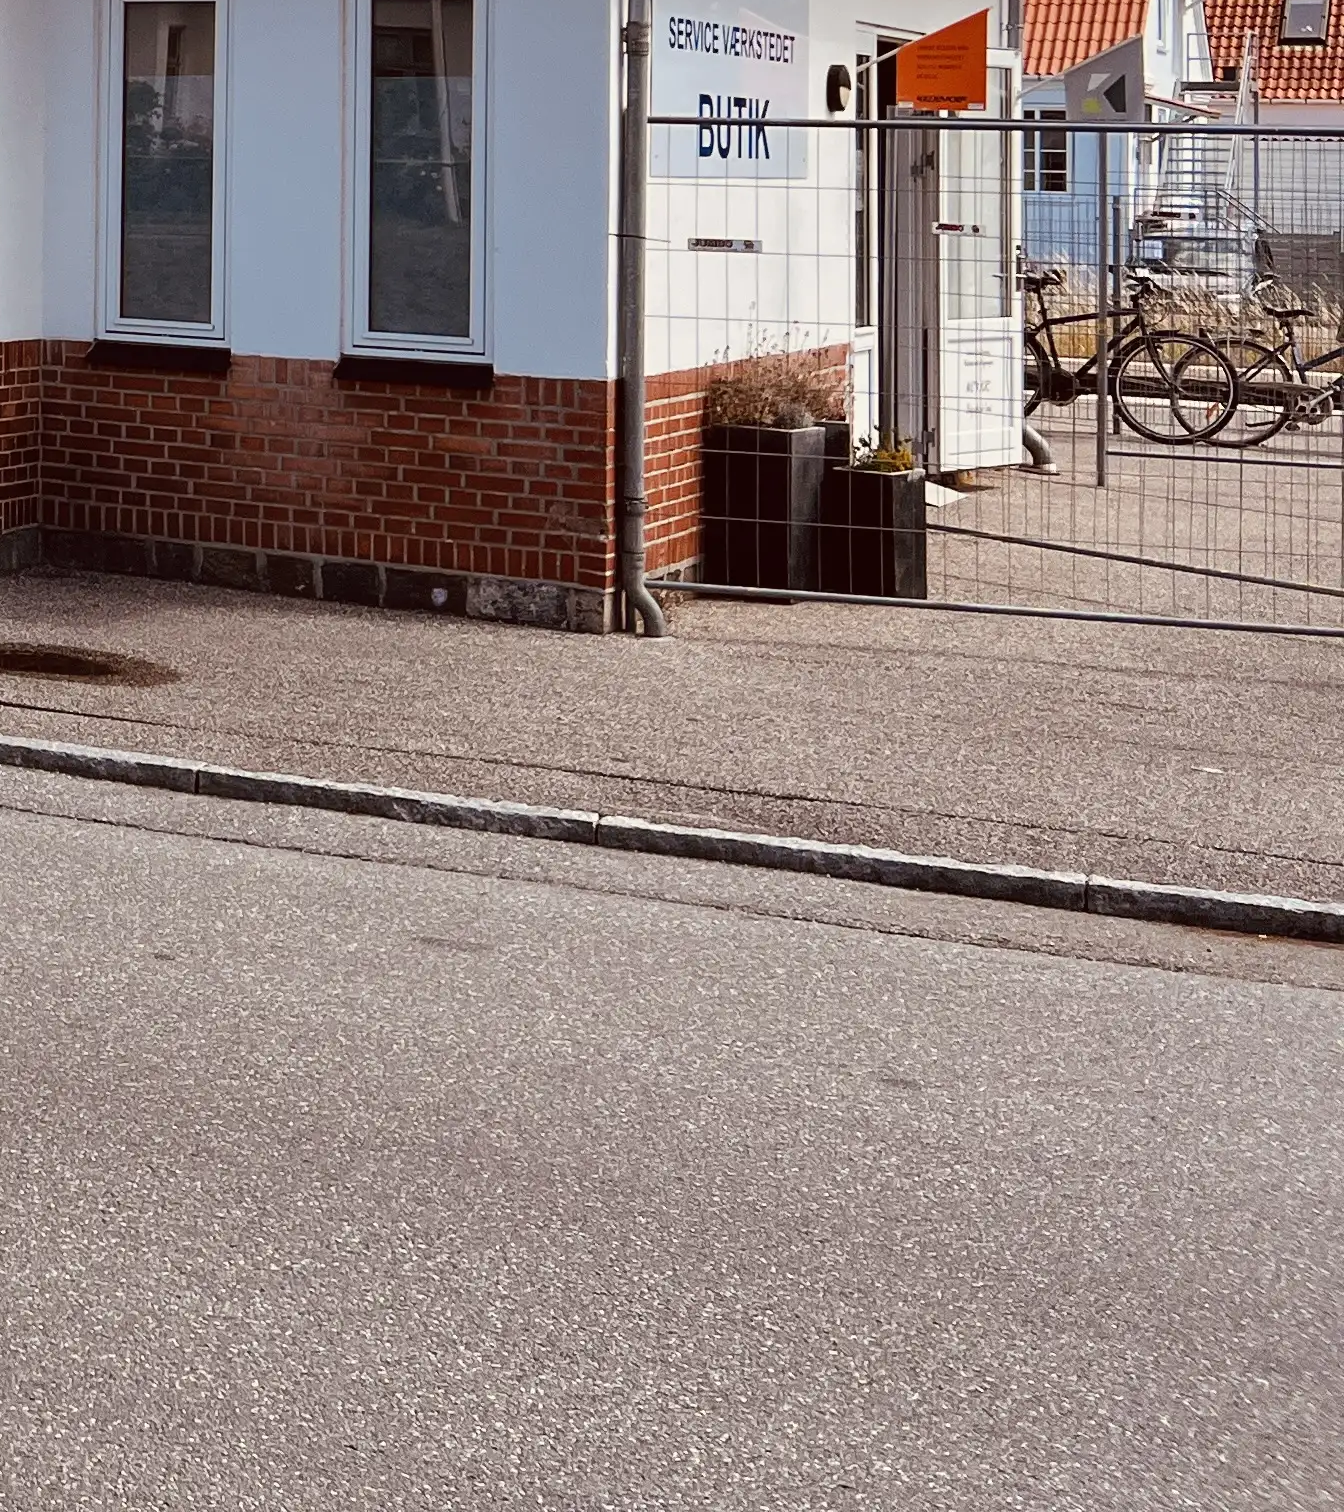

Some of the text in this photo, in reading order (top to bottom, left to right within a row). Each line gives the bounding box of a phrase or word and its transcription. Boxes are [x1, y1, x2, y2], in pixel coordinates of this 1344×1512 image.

[668, 16, 796, 65] SERVICE VÆRKSTEDET
[698, 93, 770, 160] BUTIK
